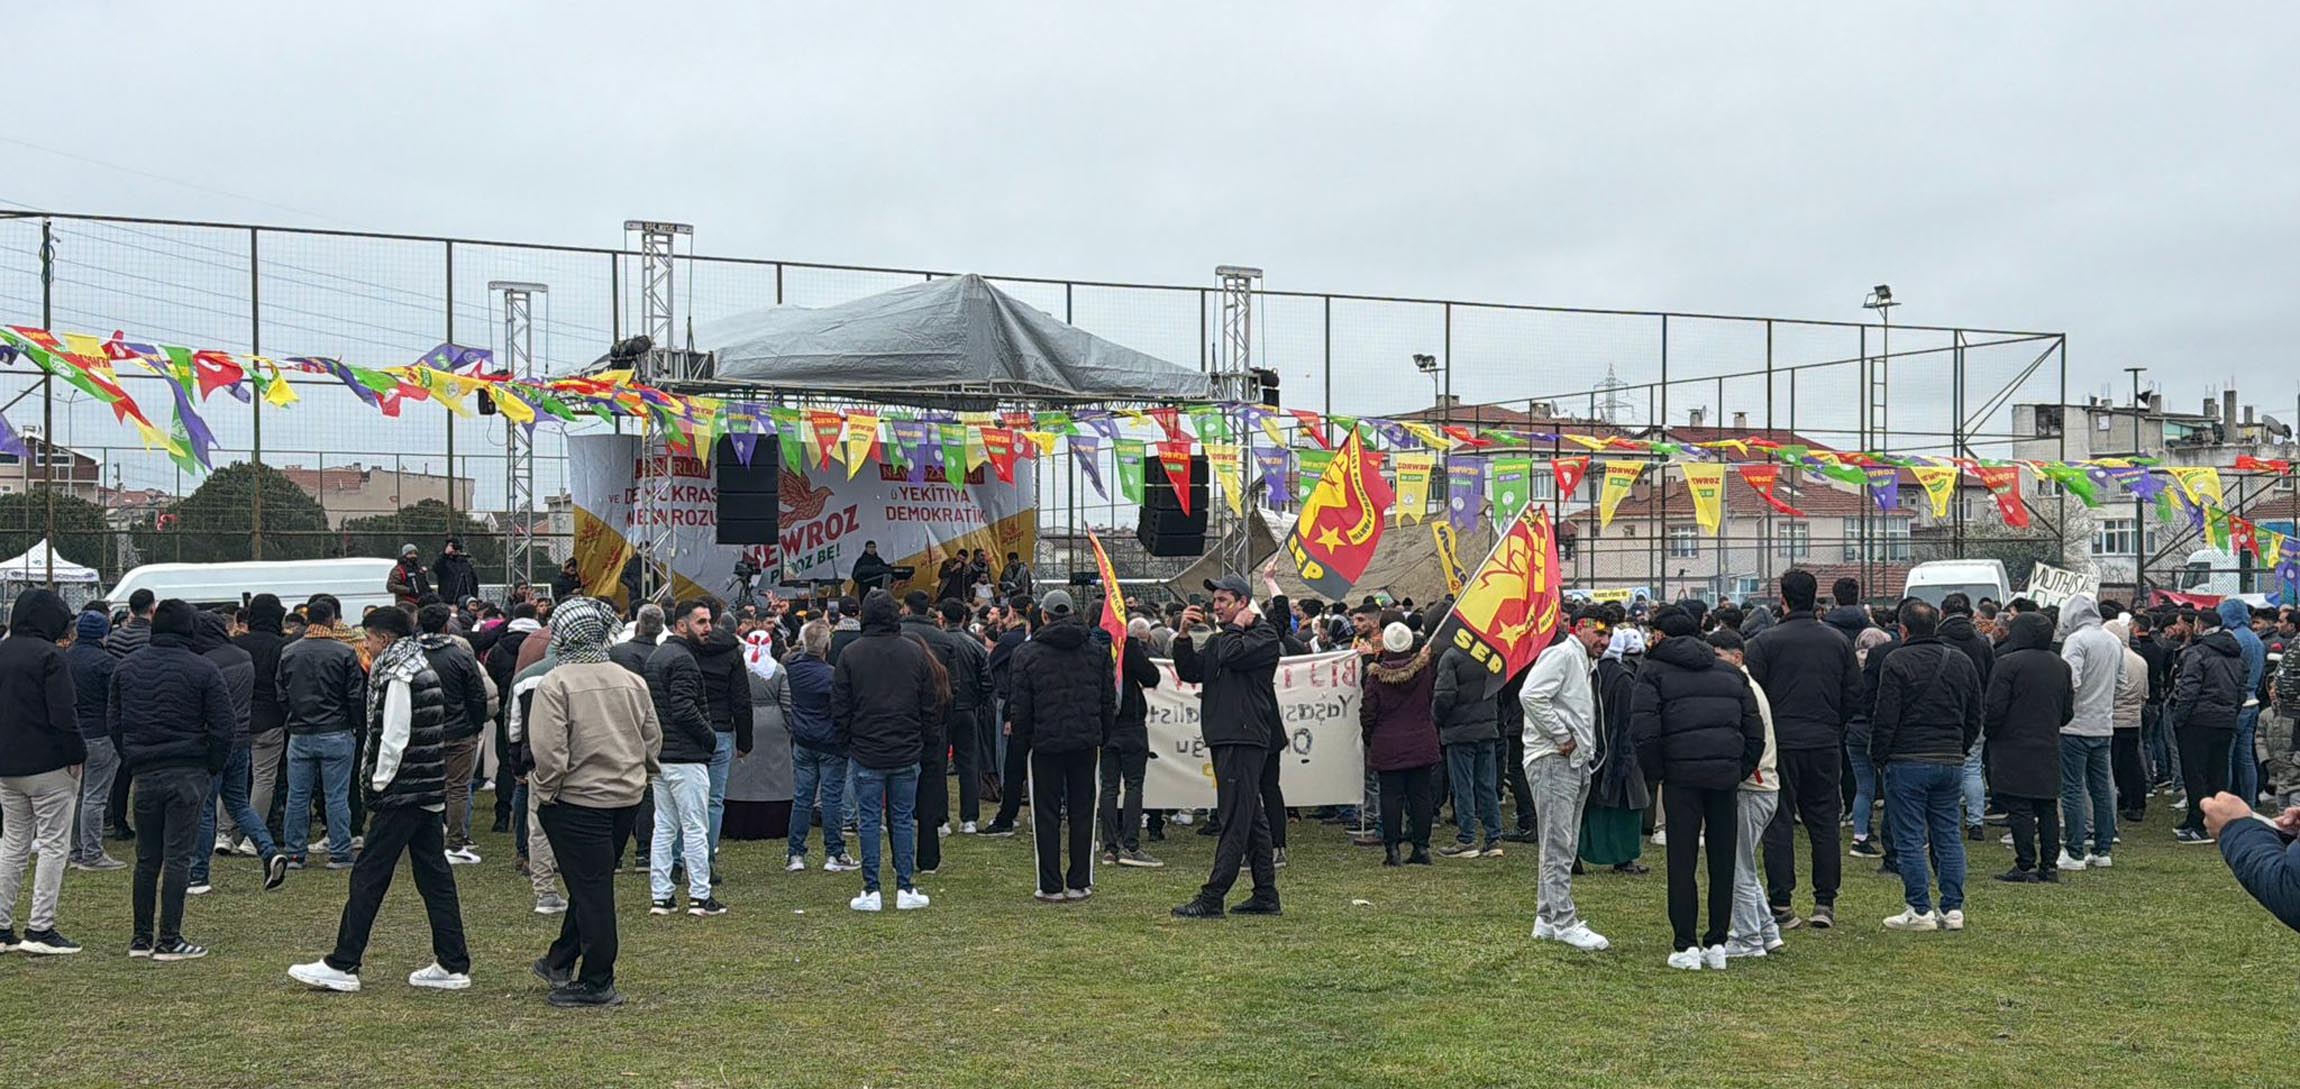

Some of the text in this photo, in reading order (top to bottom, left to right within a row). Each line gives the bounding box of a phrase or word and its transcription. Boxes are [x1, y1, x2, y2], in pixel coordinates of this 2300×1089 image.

[1868, 469, 1896, 478] WROZ
[743, 504, 859, 570] NEWROZ
[1453, 627, 1503, 674] SEP
